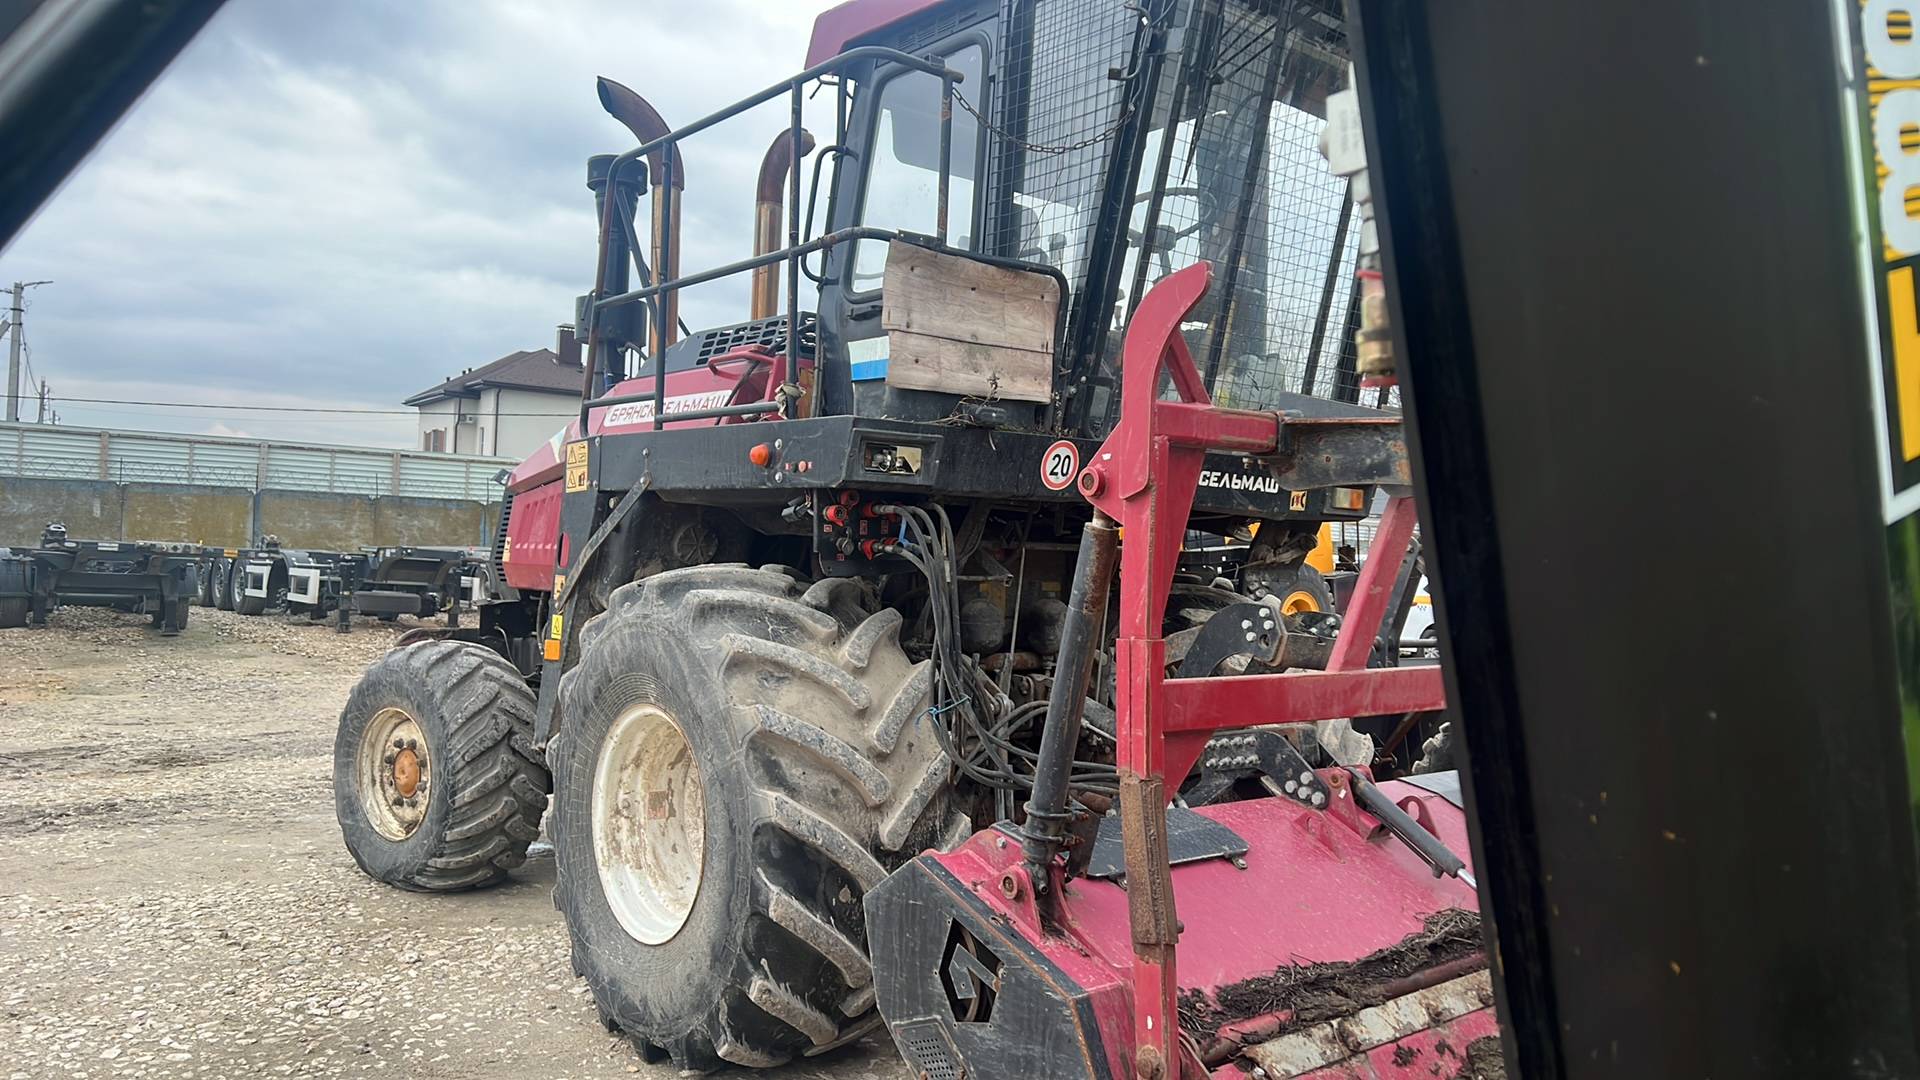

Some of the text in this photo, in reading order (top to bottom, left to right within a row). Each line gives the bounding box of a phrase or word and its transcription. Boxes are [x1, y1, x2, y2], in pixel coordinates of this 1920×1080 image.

[609, 394, 726, 423] БРЯНСКЕЛЬМАШ
[1048, 453, 1072, 477] 20
[1198, 470, 1279, 494] СЕЛЬМАШ
